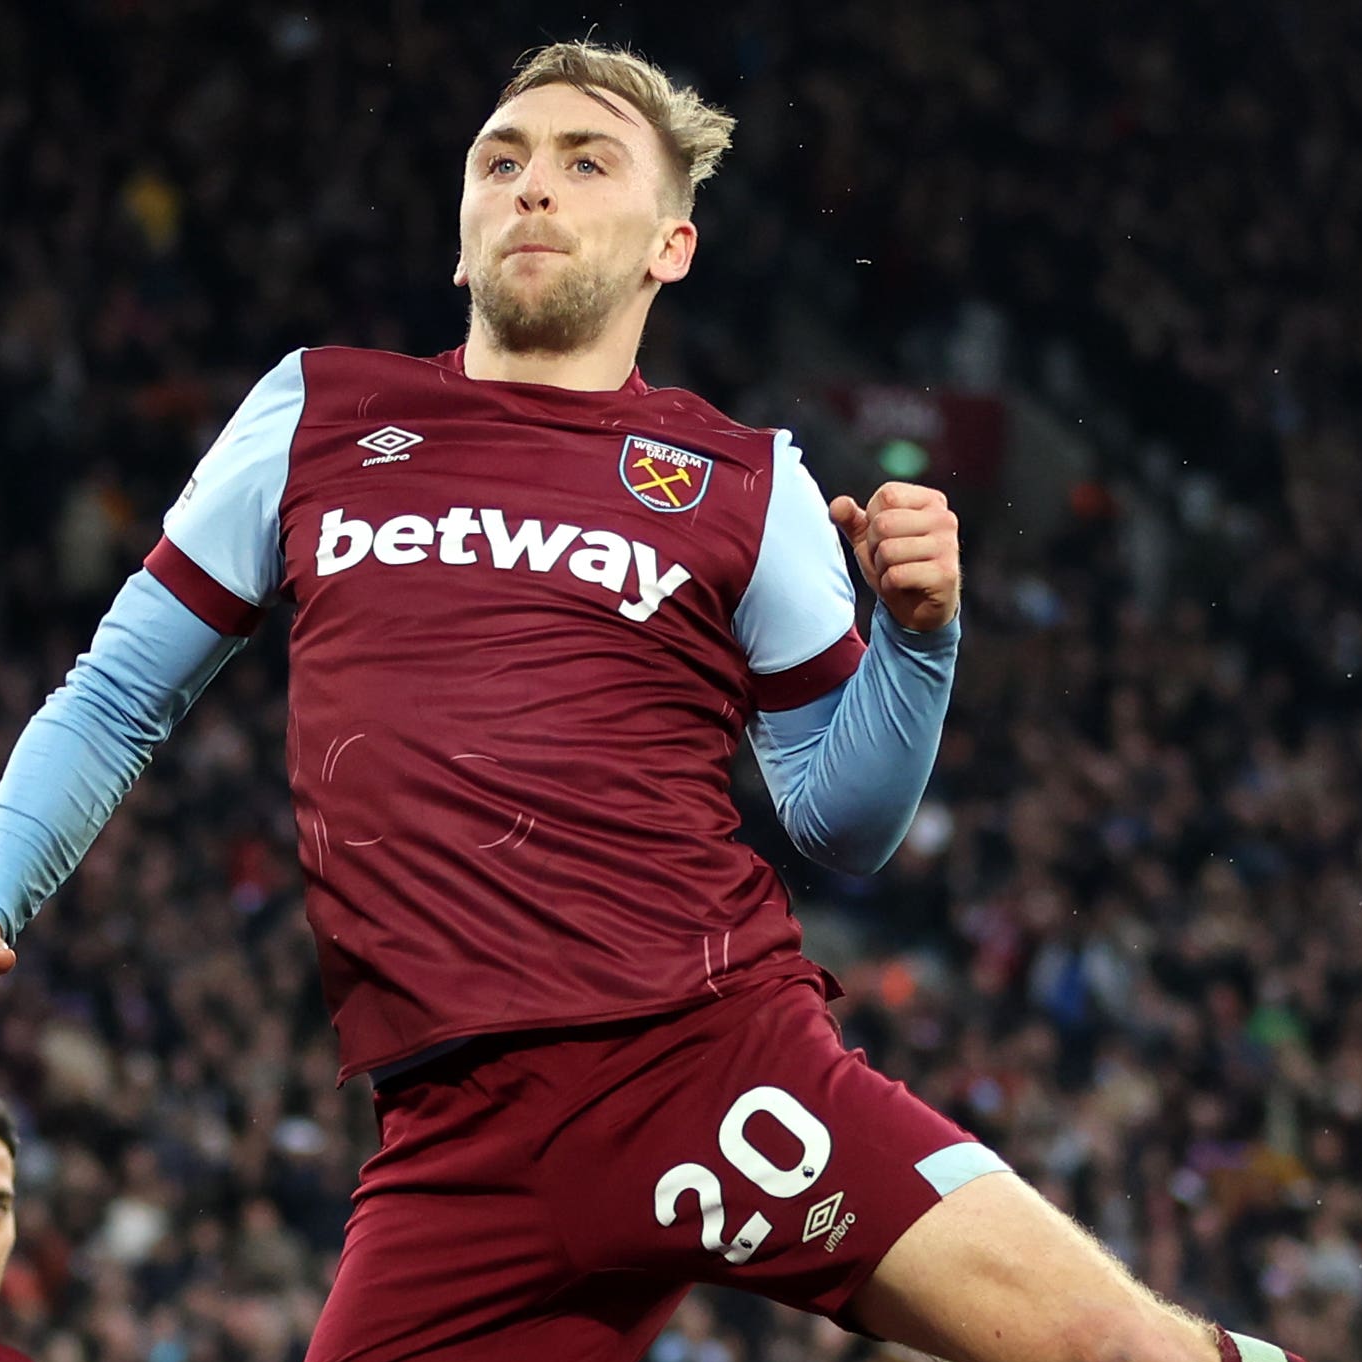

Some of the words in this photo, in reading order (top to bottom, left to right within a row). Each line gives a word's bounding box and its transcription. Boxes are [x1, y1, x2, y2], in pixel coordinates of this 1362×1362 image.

[362, 453, 411, 467] umbro
[633, 440, 670, 456] WEST
[670, 448, 702, 469] HAM
[646, 449, 687, 468] UNITED
[640, 492, 671, 508] LONDON
[315, 507, 692, 622] betway
[654, 1085, 832, 1265] 20
[823, 1212, 856, 1253] umbro
